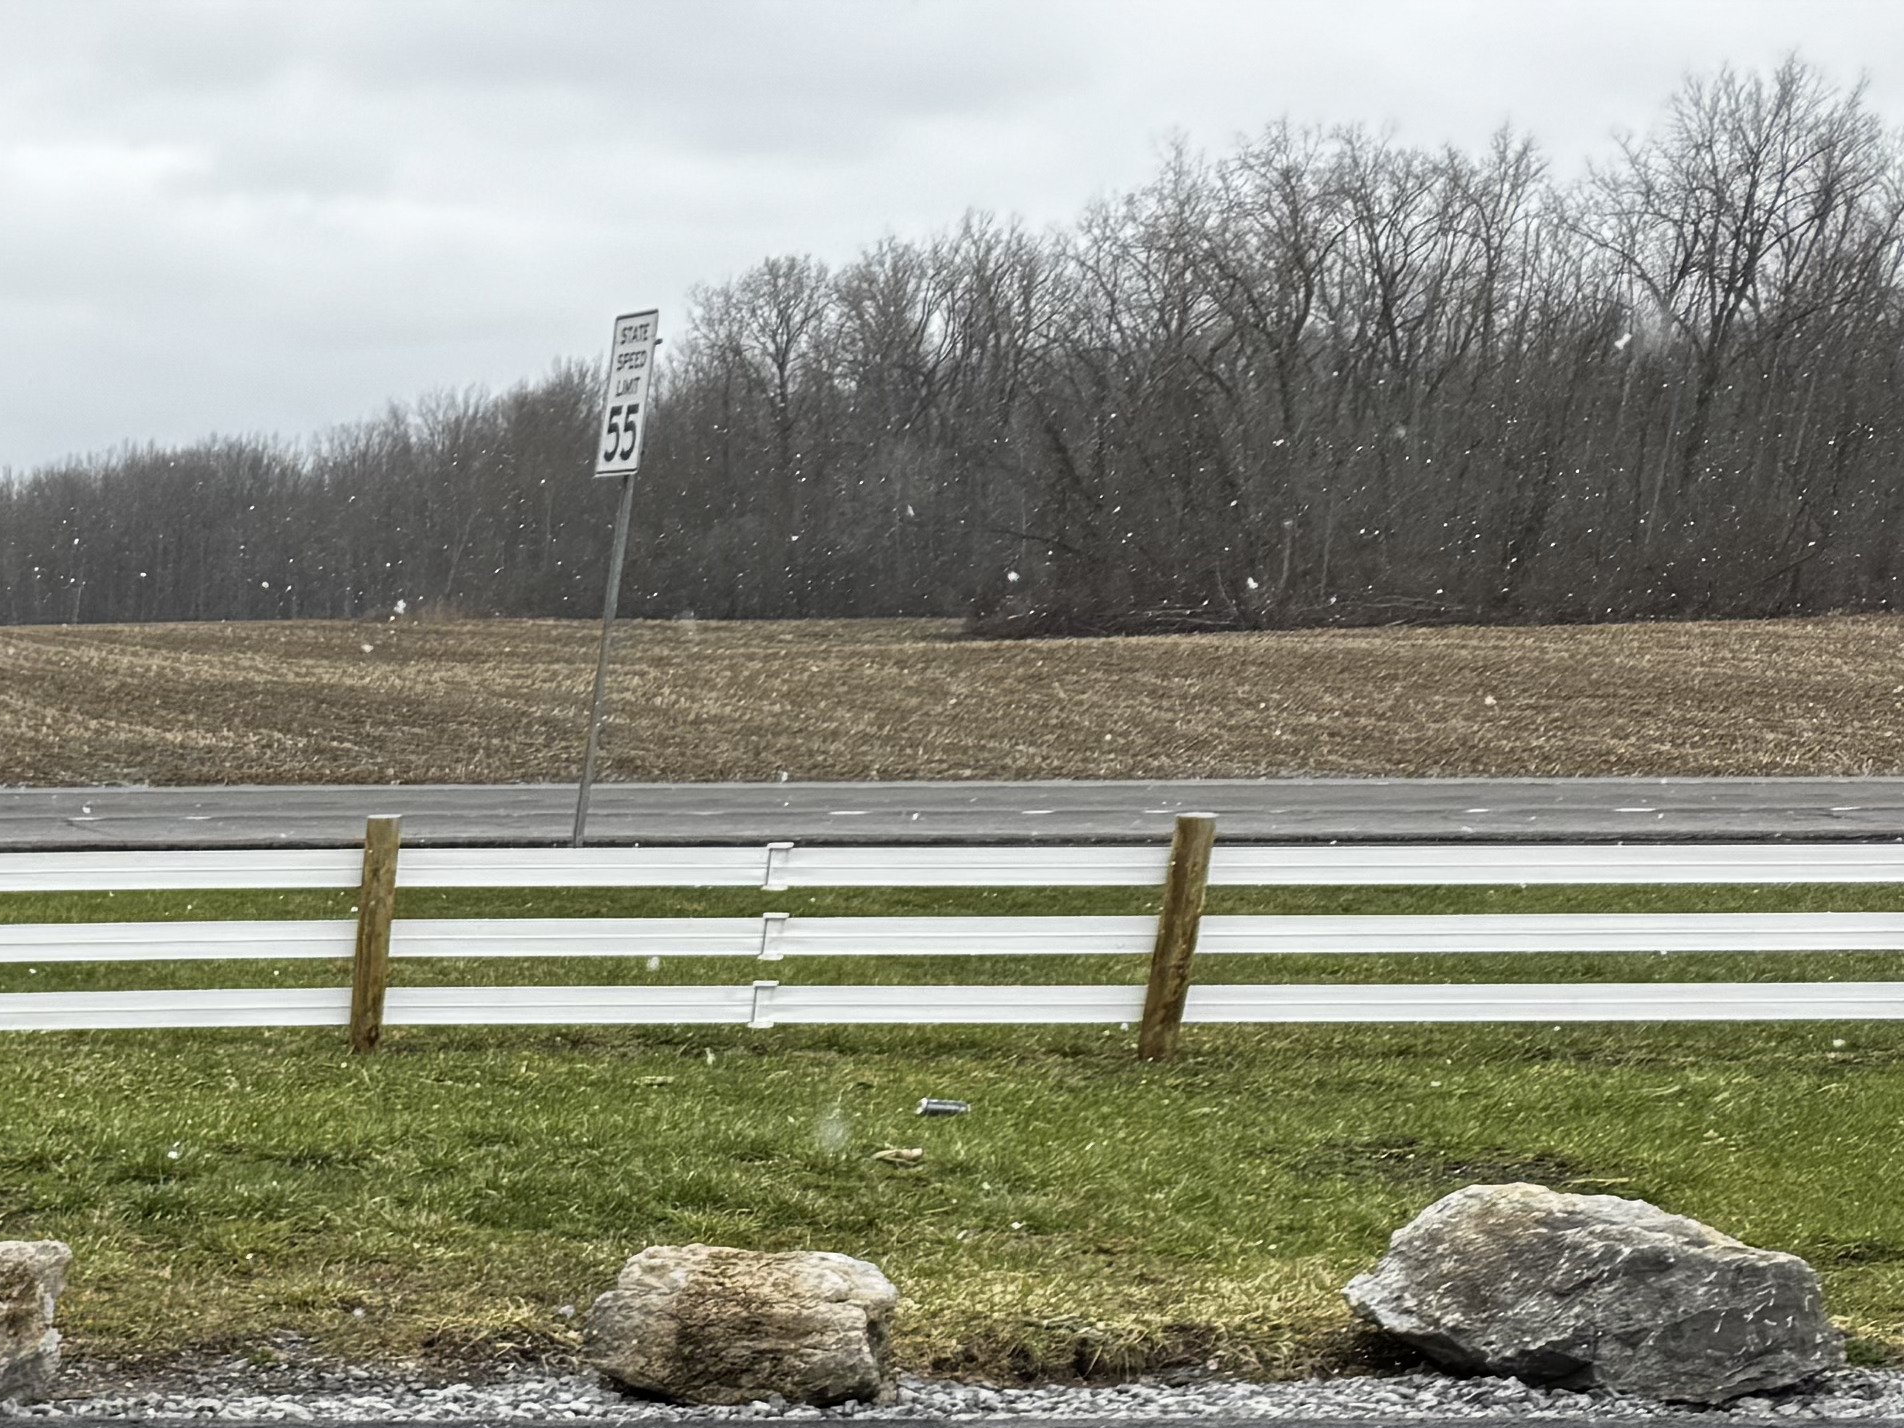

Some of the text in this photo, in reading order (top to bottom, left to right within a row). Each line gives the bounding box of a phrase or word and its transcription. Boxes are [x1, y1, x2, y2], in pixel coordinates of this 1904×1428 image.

[619, 322, 650, 345] STATE
[616, 349, 647, 372] SPEED
[614, 376, 641, 397] LIMIT
[603, 403, 640, 462] 55
